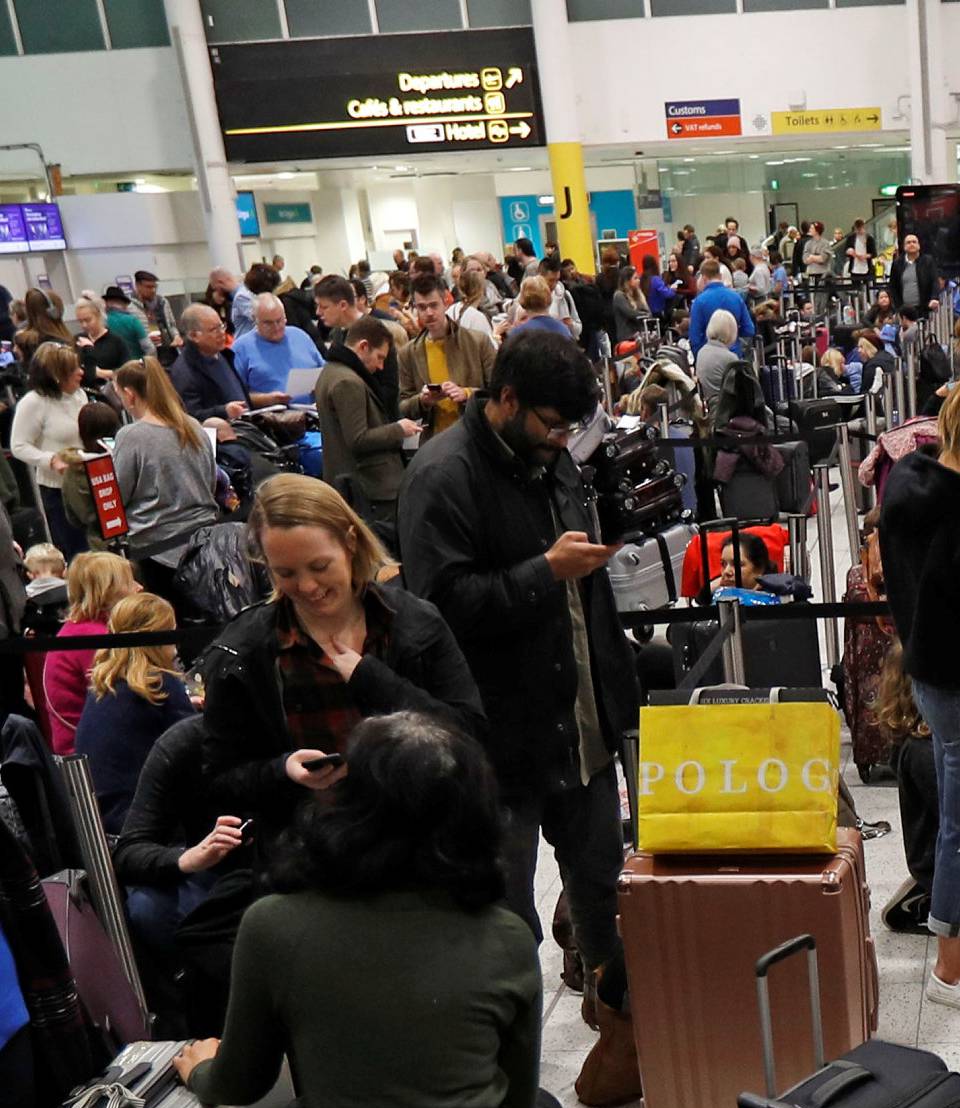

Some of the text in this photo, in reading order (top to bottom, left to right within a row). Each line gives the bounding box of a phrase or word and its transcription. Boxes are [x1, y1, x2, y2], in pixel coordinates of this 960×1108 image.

[398, 72, 480, 94] Departures
[389, 97, 403, 116] &
[403, 94, 483, 115] restaurants
[668, 105, 706, 116] Customs
[684, 122, 722, 132] VAT refunds
[785, 115, 820, 127] Toilets
[445, 121, 486, 141] Hotel
[560, 186, 573, 220] J
[98, 486, 113, 498] DROP
[102, 499, 117, 511] ONLY
